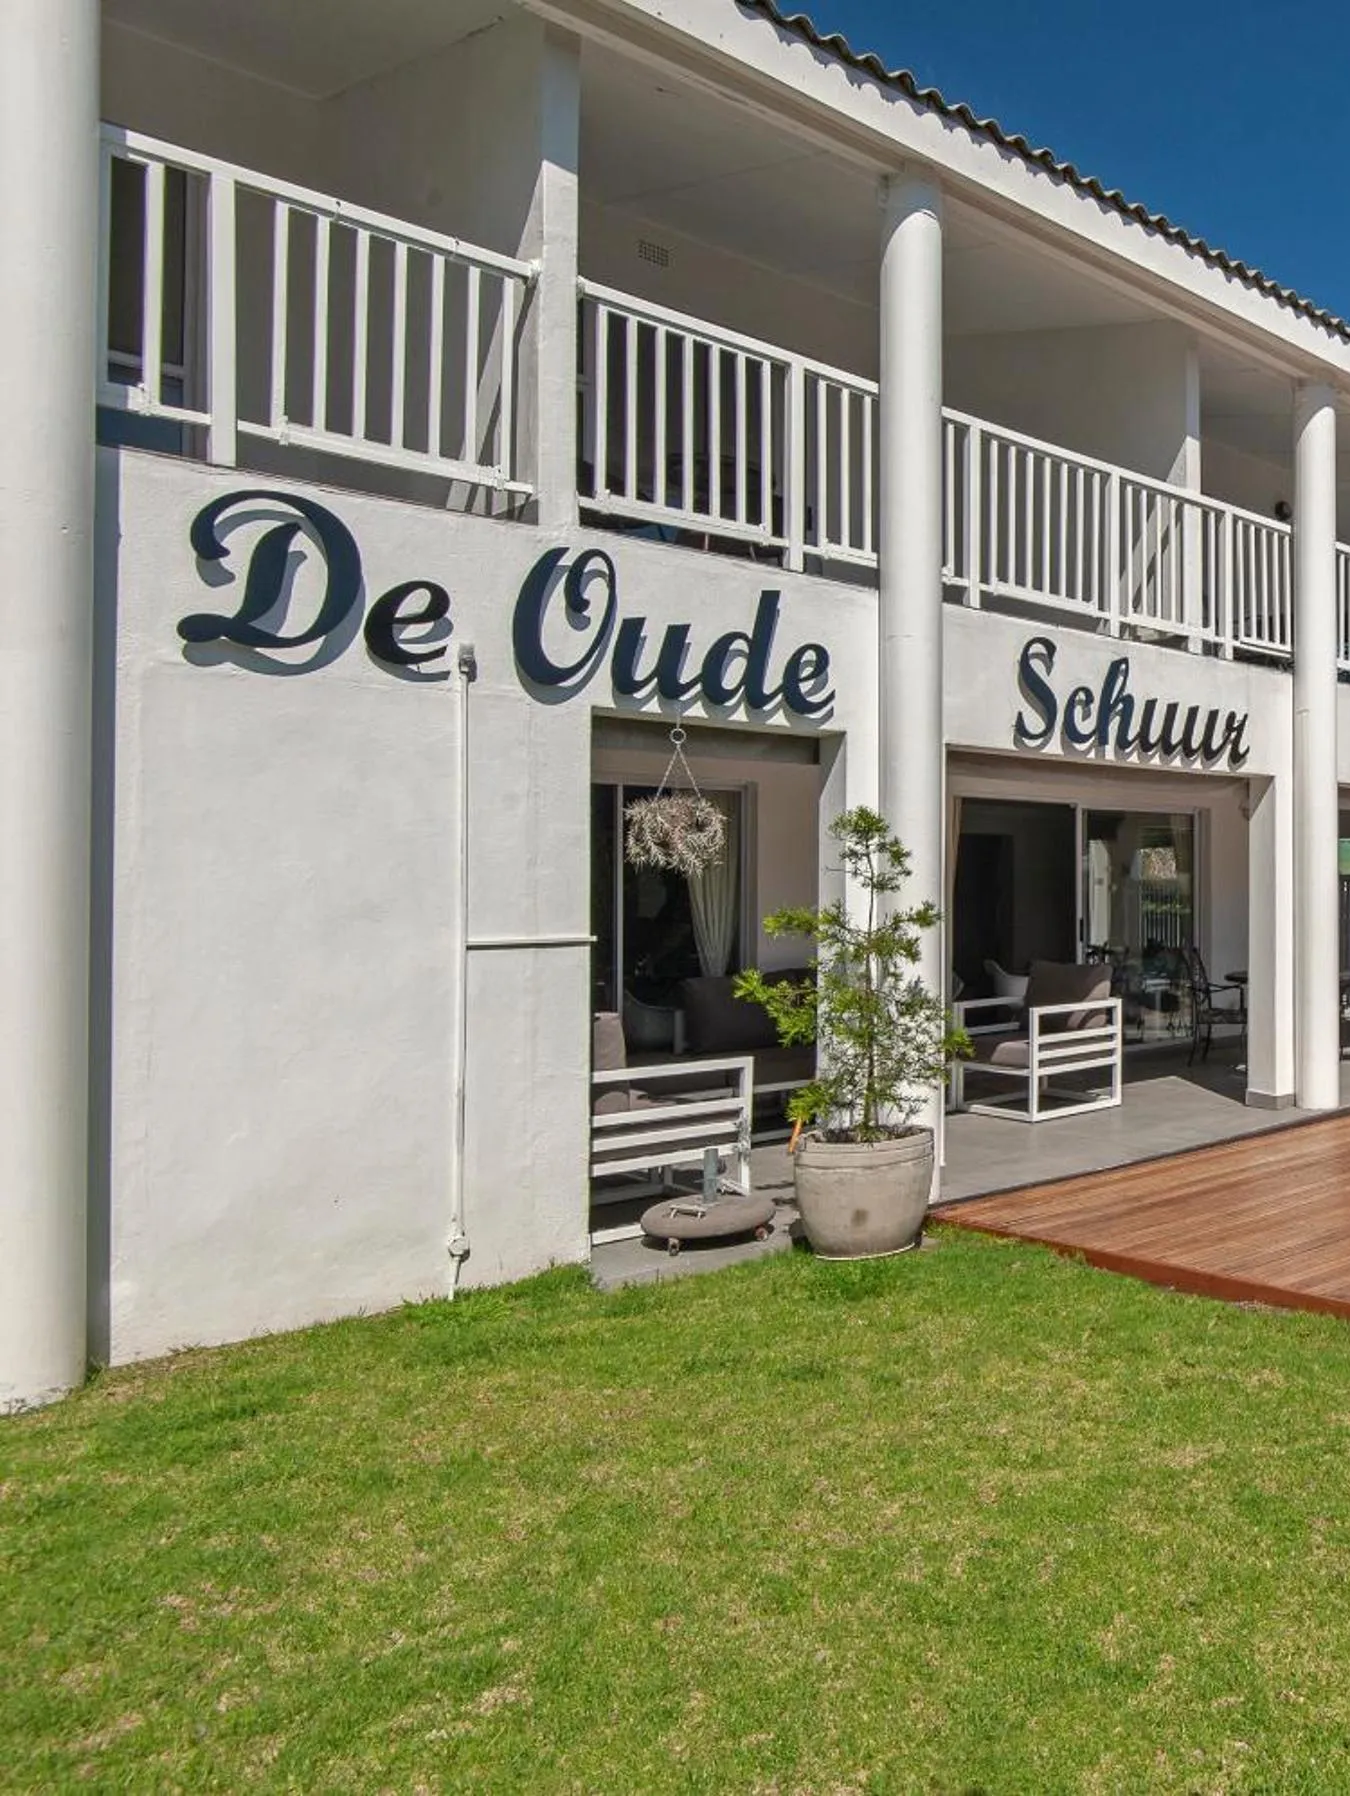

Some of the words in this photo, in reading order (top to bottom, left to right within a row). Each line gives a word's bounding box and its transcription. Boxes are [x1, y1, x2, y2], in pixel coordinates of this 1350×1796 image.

[177, 490, 450, 665] De
[513, 547, 835, 714] Oude
[1014, 637, 1250, 764] Schuur
